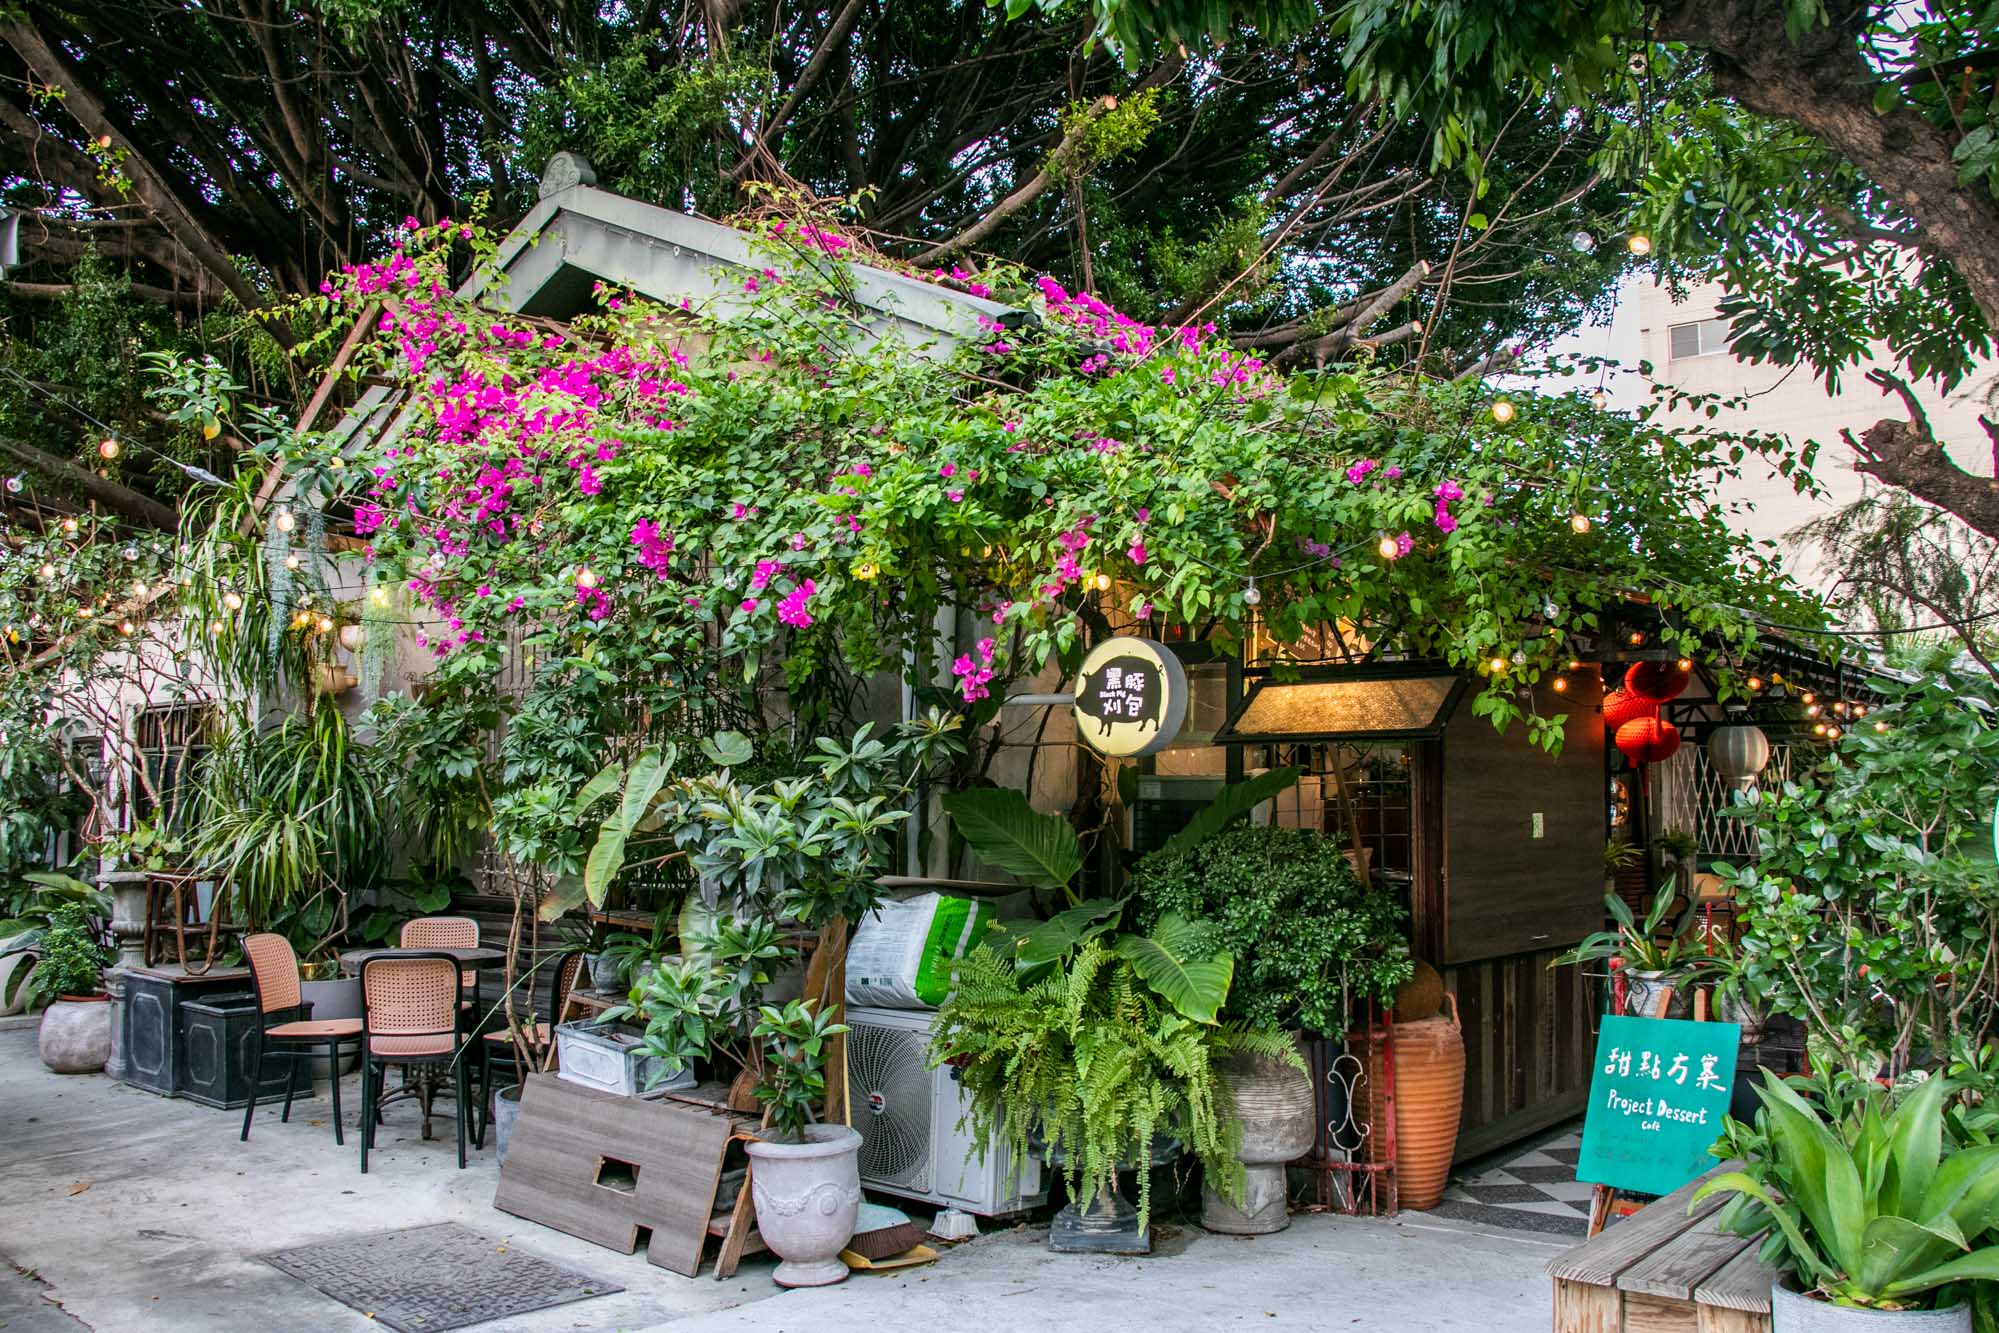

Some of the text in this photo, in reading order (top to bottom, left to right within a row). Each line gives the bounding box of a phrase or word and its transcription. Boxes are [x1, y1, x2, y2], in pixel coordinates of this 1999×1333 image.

[1106, 667, 1145, 691] 黑豚
[1103, 693, 1143, 717] 刈包
[1604, 1047, 1727, 1092] 甜點方案
[1607, 1088, 1708, 1125] Project Dessert
